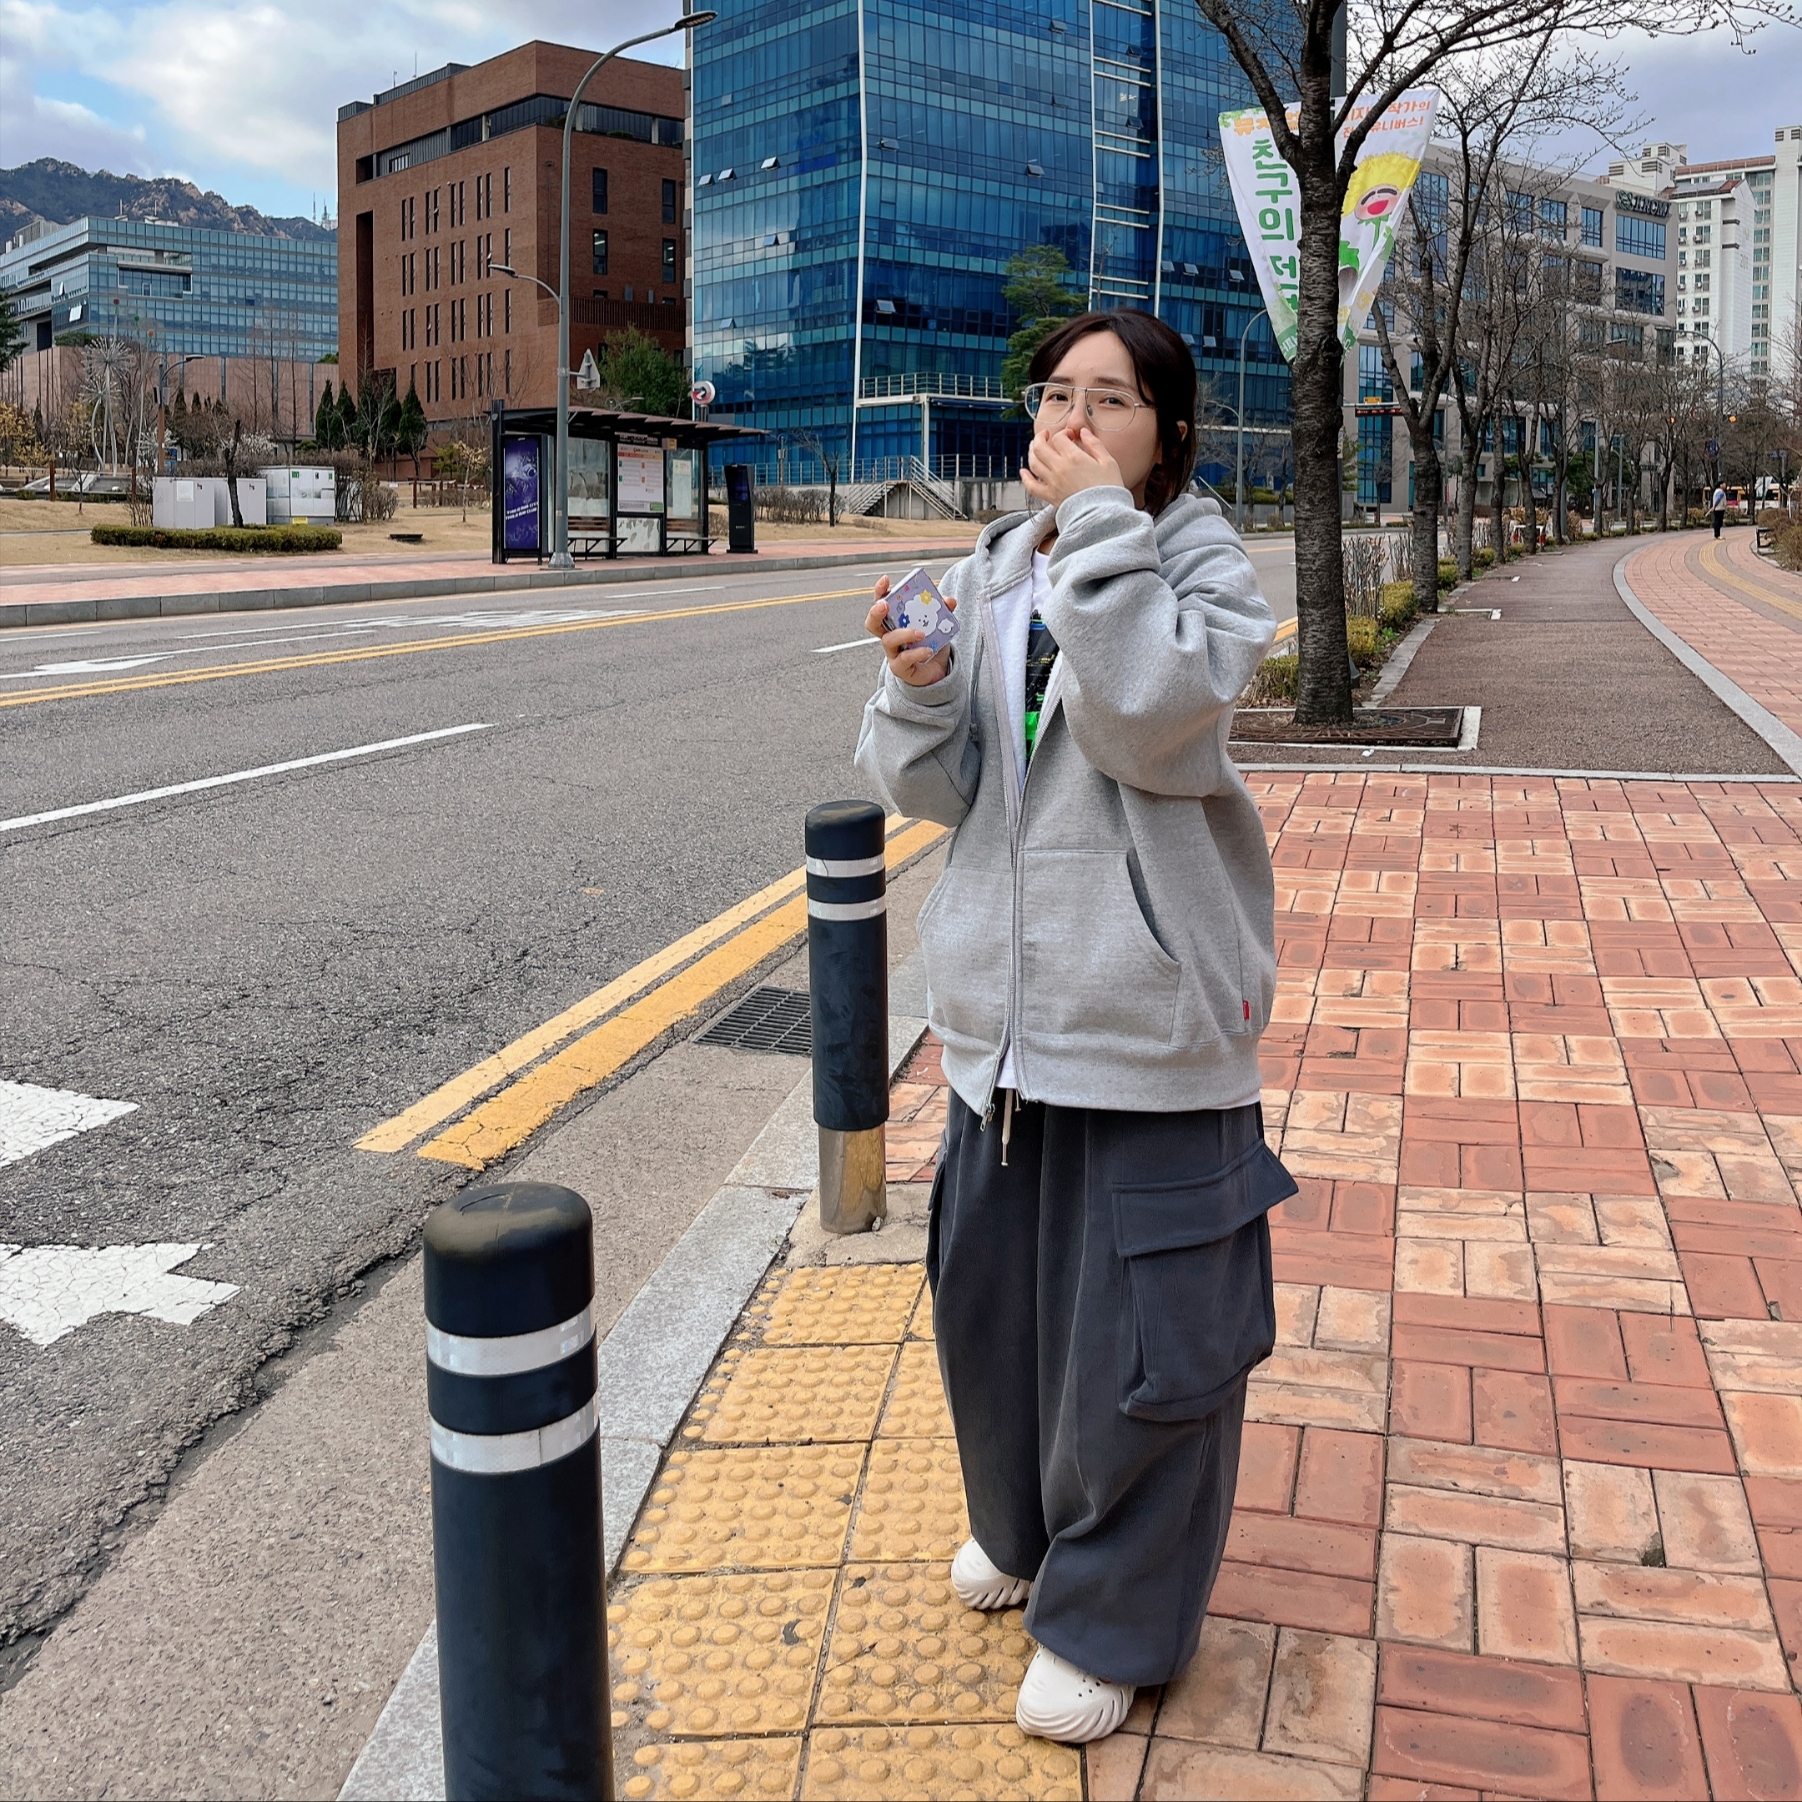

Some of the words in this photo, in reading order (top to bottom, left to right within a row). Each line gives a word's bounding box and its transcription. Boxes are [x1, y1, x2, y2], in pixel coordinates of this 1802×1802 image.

[1387, 100, 1431, 115] 작가의
[1371, 116, 1424, 133] 유니버스!
[1252, 138, 1295, 241] 친구의
